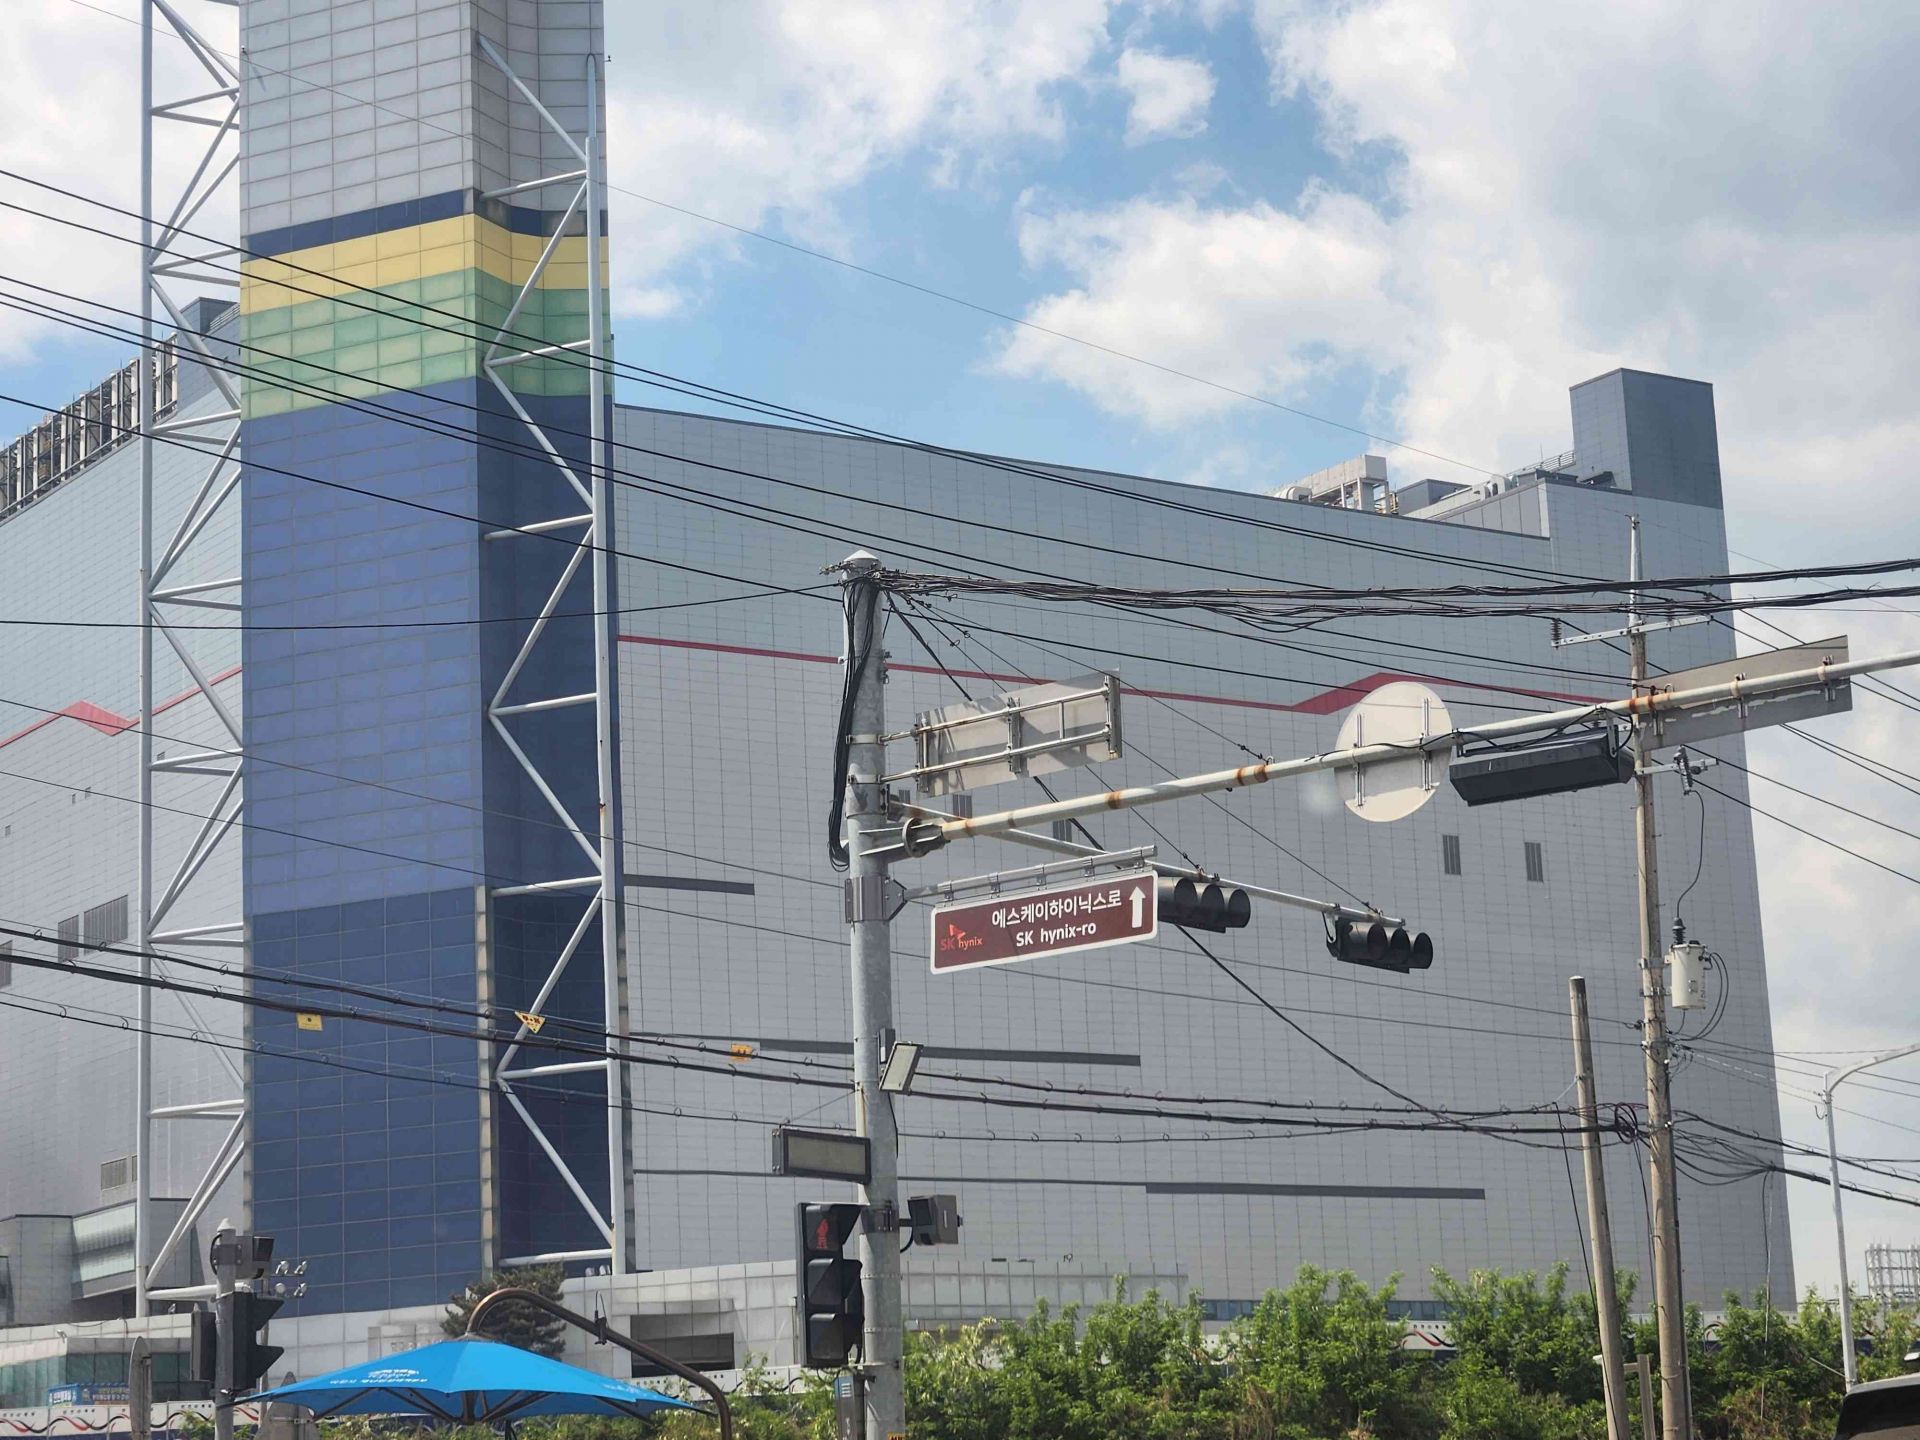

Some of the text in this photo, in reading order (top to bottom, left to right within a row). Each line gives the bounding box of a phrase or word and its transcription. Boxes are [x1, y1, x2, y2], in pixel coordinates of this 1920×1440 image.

[992, 889, 1122, 928] 에스케이하이닉스로
[940, 936, 983, 951] SK hynix
[1016, 922, 1097, 947] SK hynix-ro
